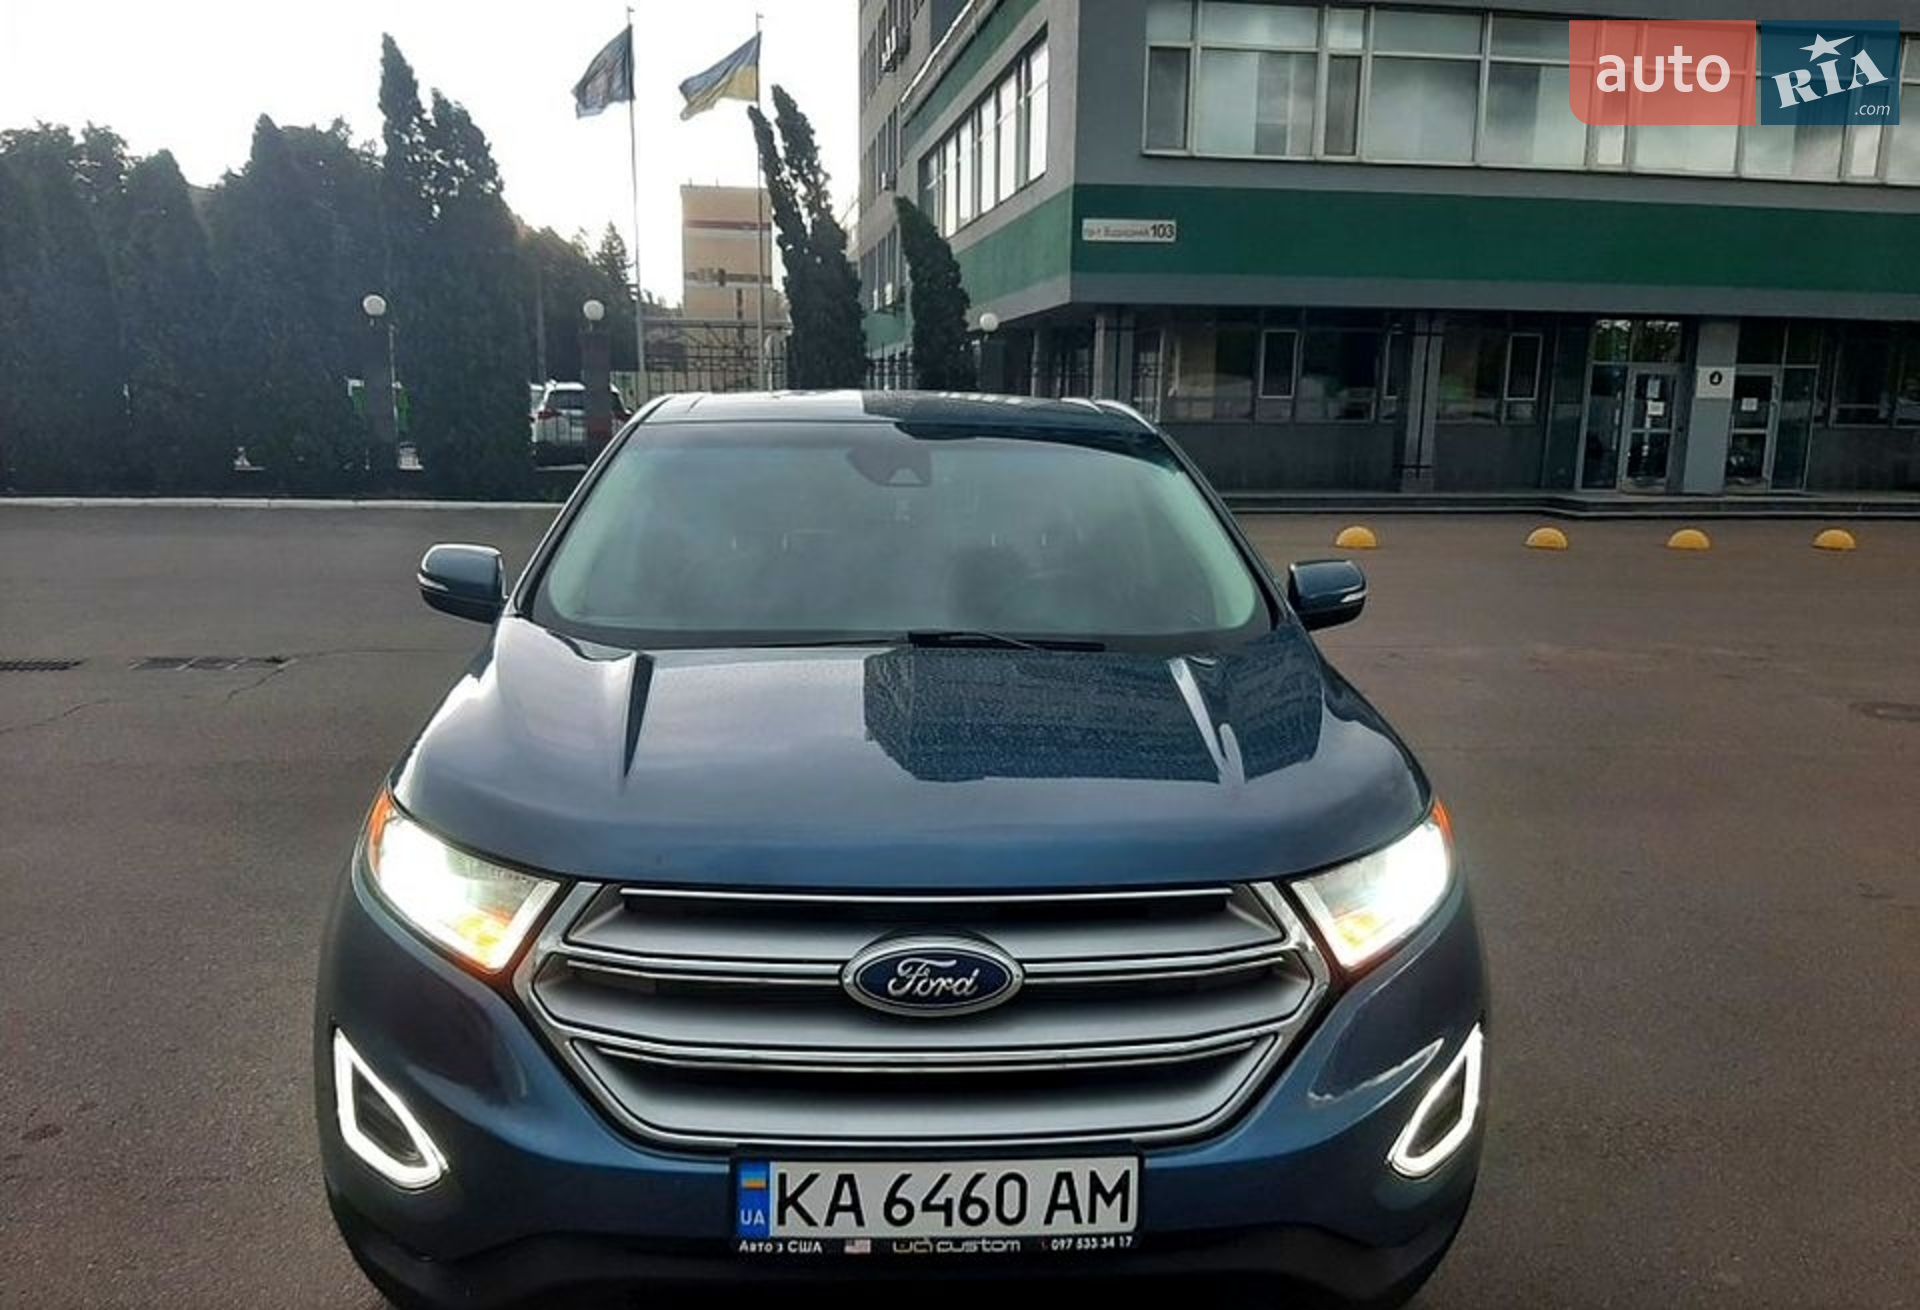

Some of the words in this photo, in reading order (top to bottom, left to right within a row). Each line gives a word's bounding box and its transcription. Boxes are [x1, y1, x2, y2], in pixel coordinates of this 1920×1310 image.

[1150, 223, 1175, 239] 103
[887, 957, 981, 997] Ford
[776, 1172, 866, 1228] KA
[883, 1171, 1028, 1228] 6460
[1043, 1169, 1131, 1225] AM
[740, 1209, 766, 1227] UA
[787, 1240, 823, 1254] США
[936, 1238, 1021, 1254] custom
[1119, 1235, 1133, 1248] 17
